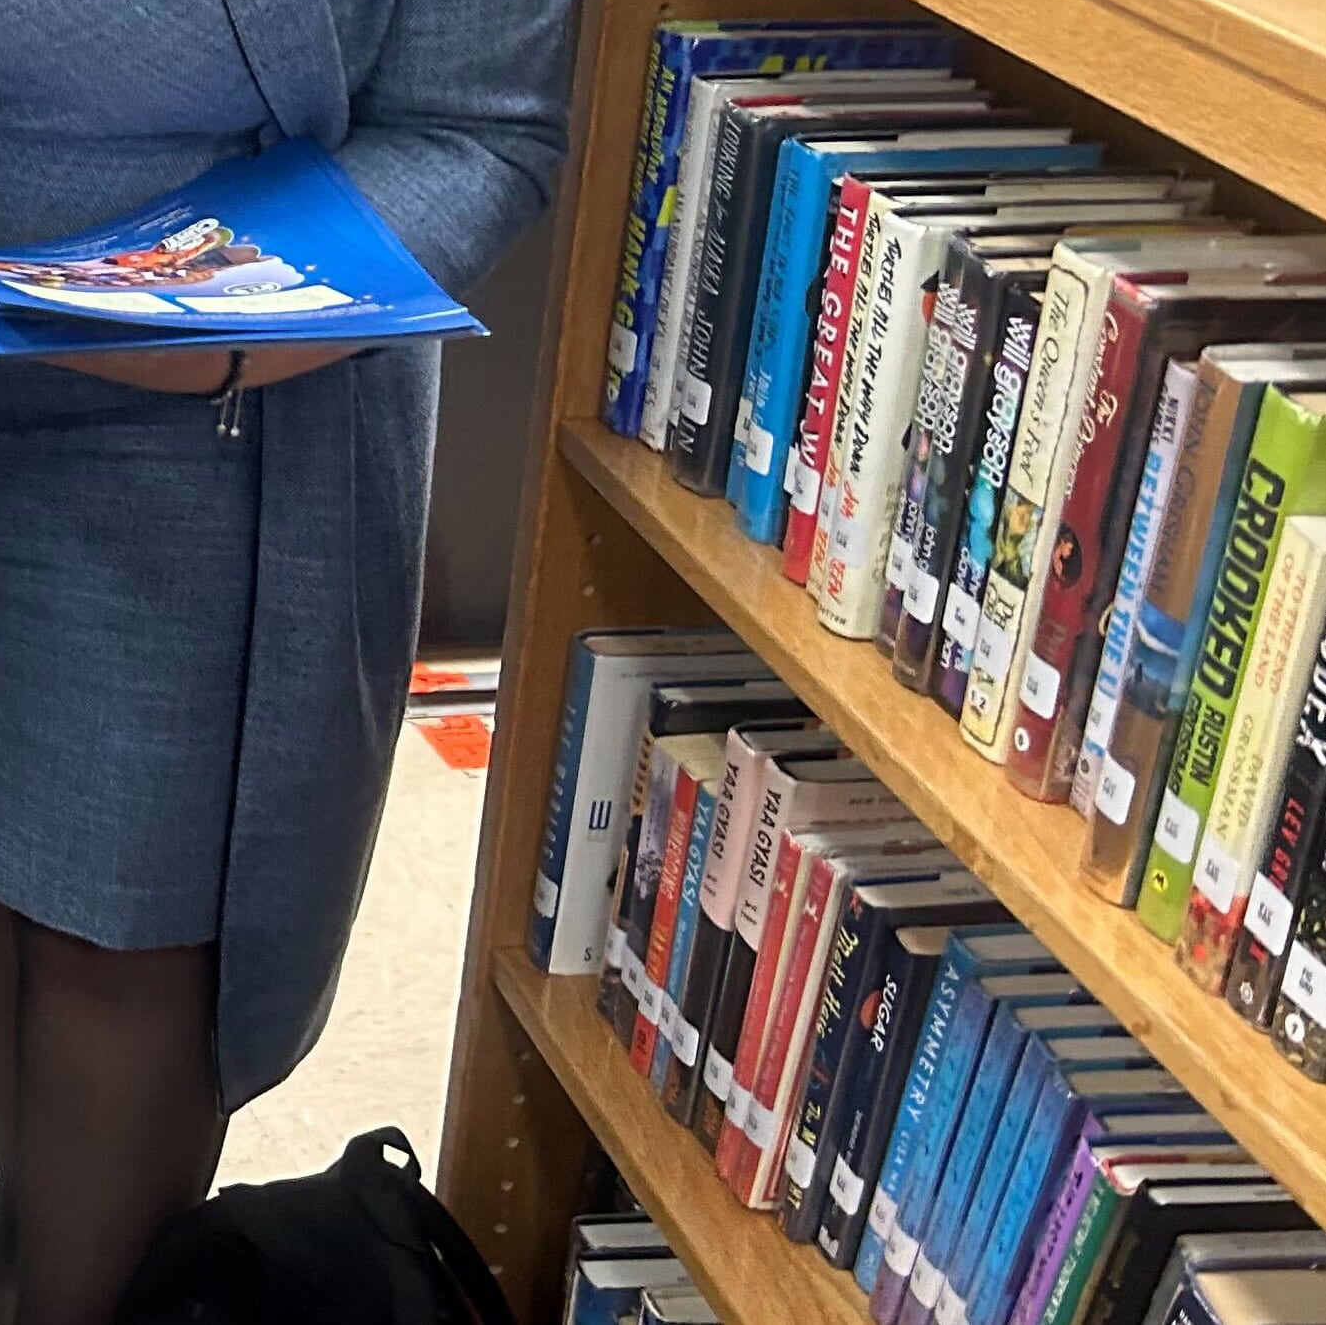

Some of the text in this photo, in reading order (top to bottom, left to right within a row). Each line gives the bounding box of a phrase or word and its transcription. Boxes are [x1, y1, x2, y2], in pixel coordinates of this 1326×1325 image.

[646, 66, 675, 184] AN ABSOLUTELY
[712, 115, 743, 200] LOOKING
[621, 212, 647, 299] HANK
[701, 228, 726, 297] ALASKA
[831, 207, 859, 275] THE
[860, 213, 881, 280] TURTLES
[852, 278, 870, 314] ALL
[691, 309, 714, 381] JOHN
[807, 291, 842, 416] GREAT
[849, 235, 902, 478] TURTLES ALL THE WAY DOWN
[915, 282, 960, 430] will grayson
[932, 303, 978, 455] will grayson
[981, 317, 1033, 489] will grayson
[1019, 290, 1070, 490] The Queen's Fool
[1096, 389, 1119, 429] The
[1163, 396, 1180, 445] NIKKI
[1184, 377, 1217, 454] JOHN
[1118, 451, 1163, 602] BETWEEN
[1198, 456, 1287, 701] CROOKED
[1104, 607, 1131, 665] THE
[1188, 703, 1227, 787] AUSTIN
[1216, 714, 1254, 839] GROSSMAN
[711, 761, 740, 861] YAA GYASI
[1236, 753, 1264, 829] DAVID
[1280, 797, 1306, 848] LEV
[748, 786, 782, 888] YAA GYASI
[815, 924, 859, 1040] Matt Haig
[869, 972, 898, 1054] SUGAR
[906, 961, 961, 1125] ASYMMETRY
